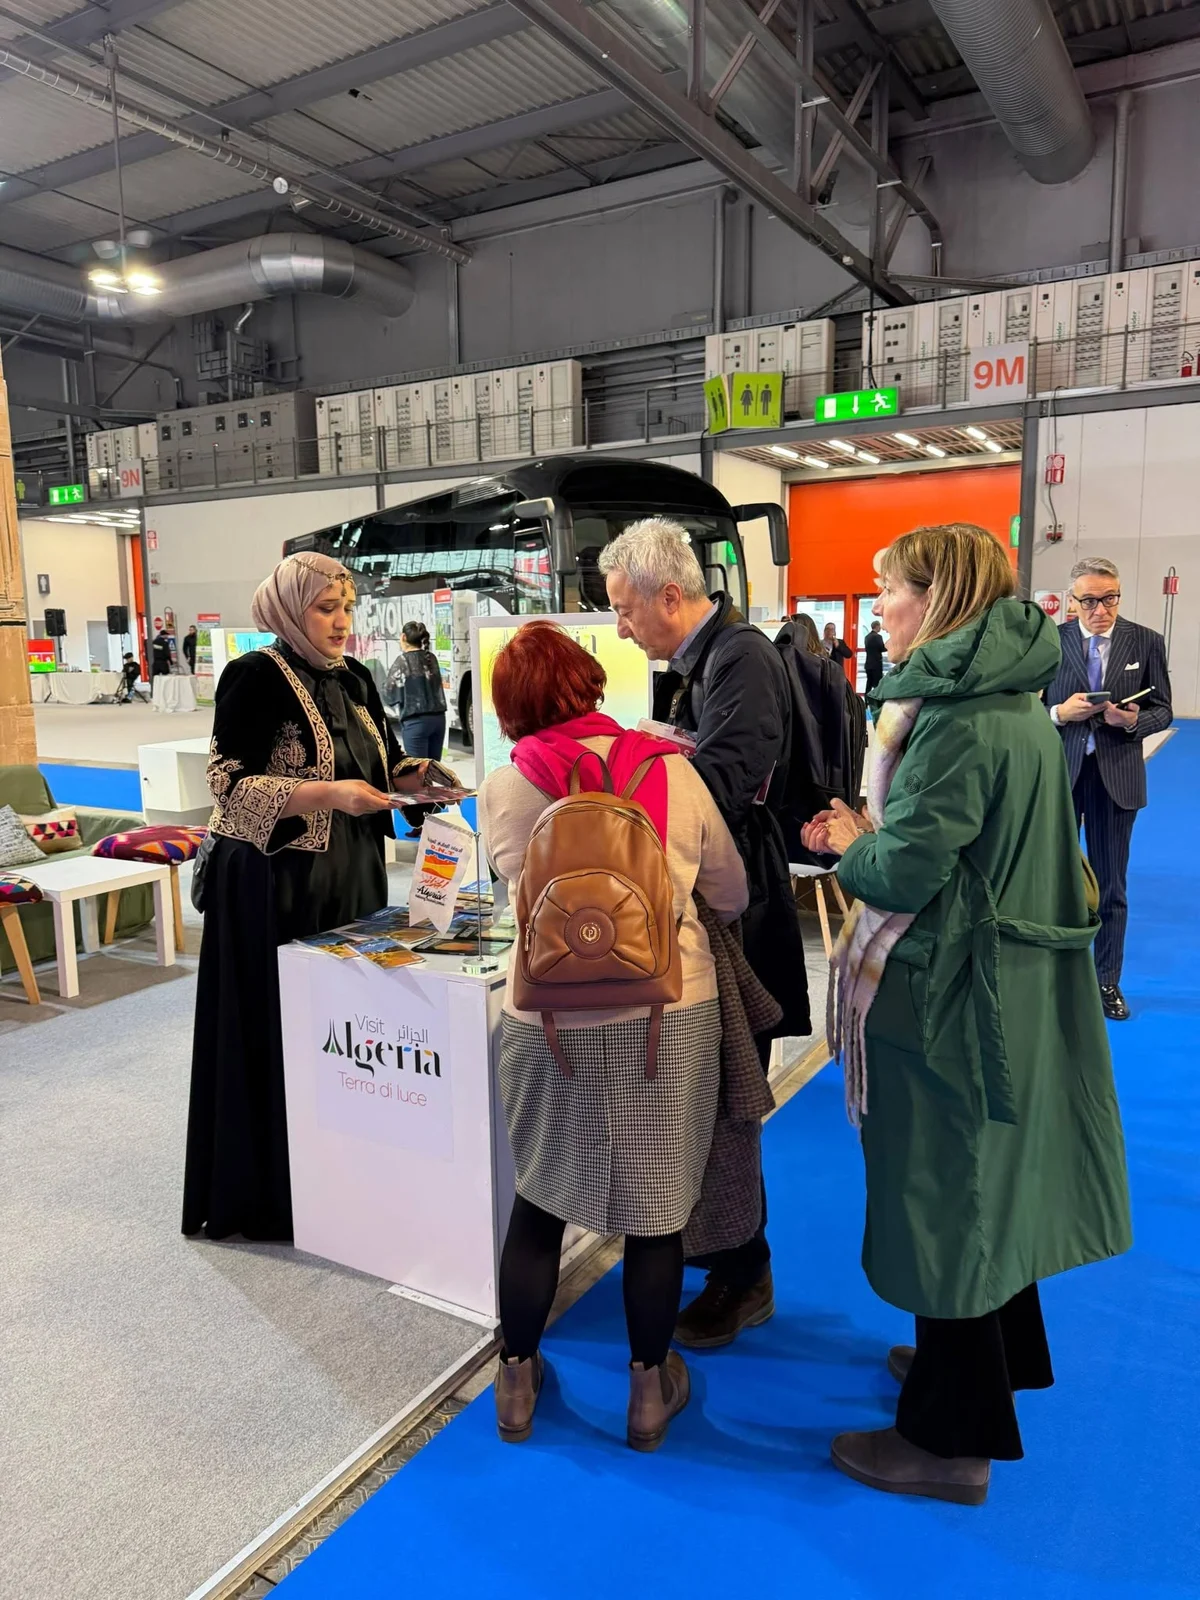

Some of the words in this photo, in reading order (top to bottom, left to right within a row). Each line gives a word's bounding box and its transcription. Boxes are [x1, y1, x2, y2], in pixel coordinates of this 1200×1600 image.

[974, 356, 1025, 390] 9M
[121, 468, 140, 488] 9N
[1040, 600, 1060, 610] STOP
[355, 1013, 385, 1035] Visit
[397, 1024, 428, 1045] الجزائر
[322, 1018, 441, 1078] Algeria
[338, 1070, 375, 1095] Terra
[380, 1082, 392, 1098] di
[397, 1084, 427, 1107] luce
